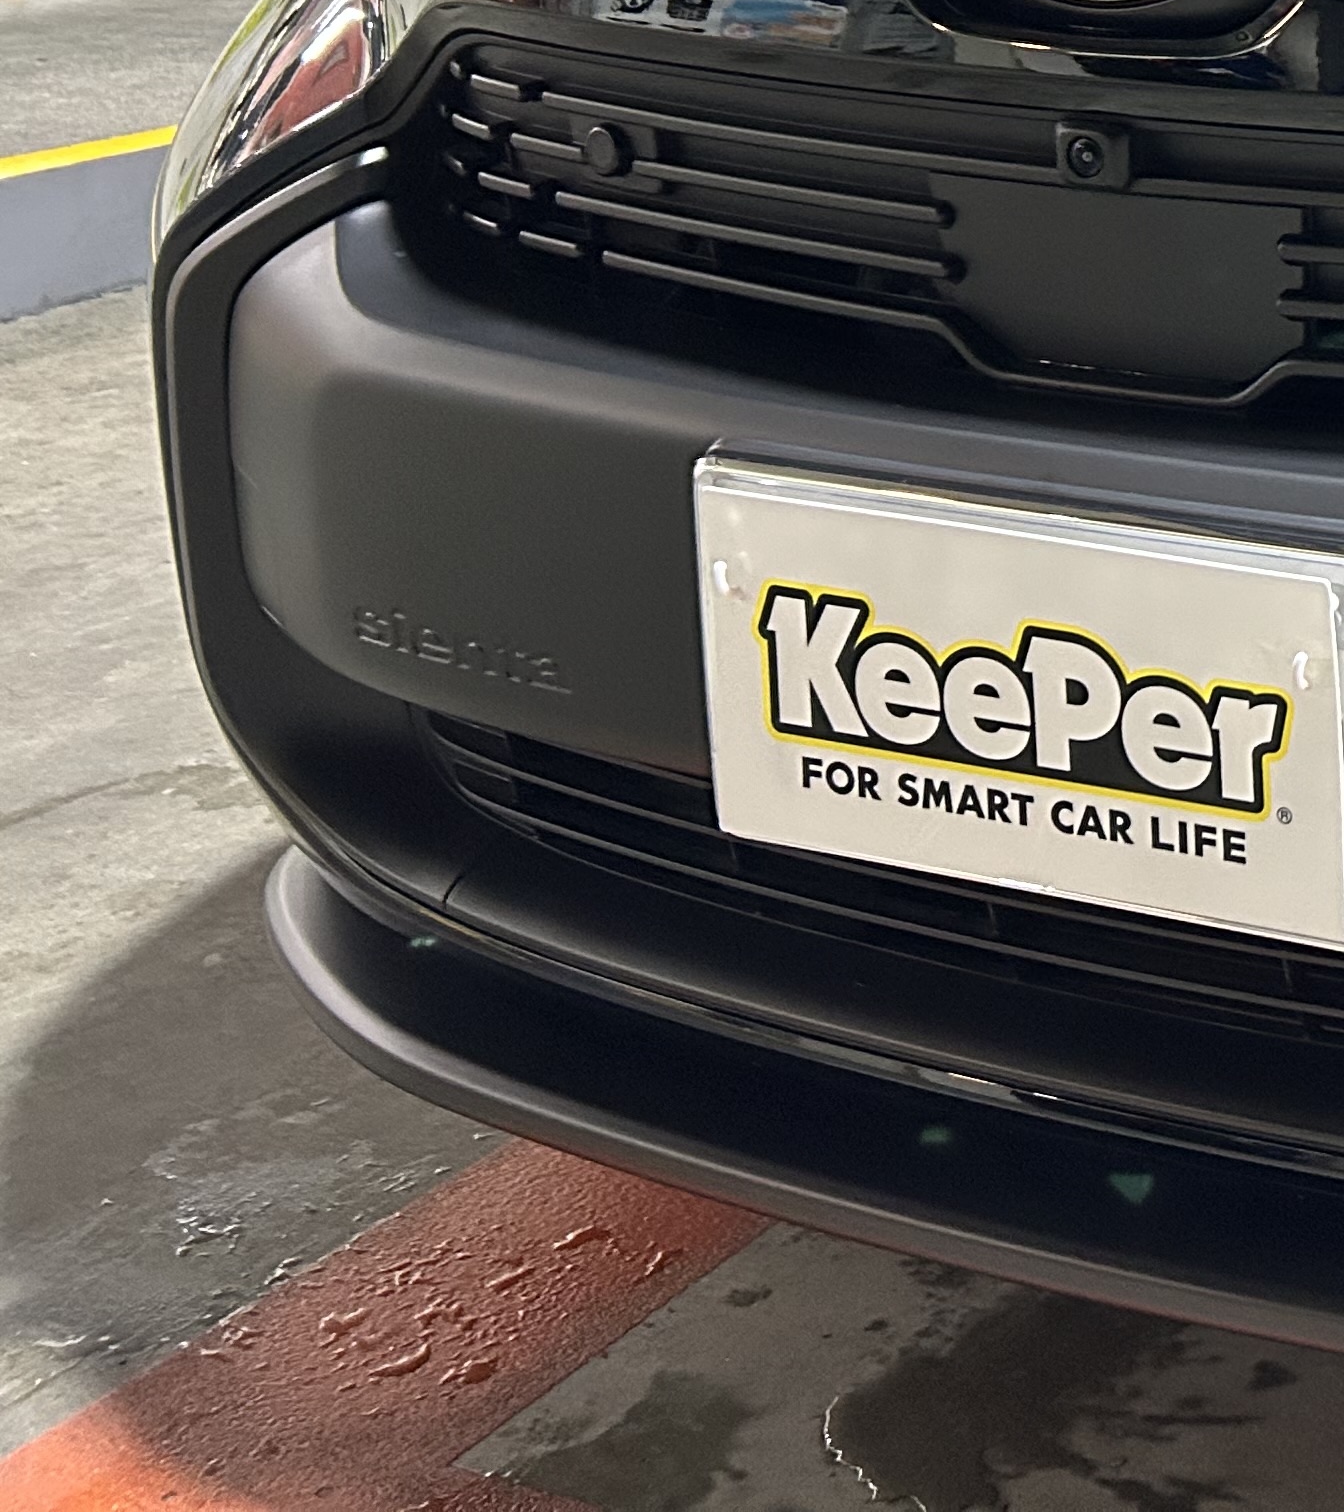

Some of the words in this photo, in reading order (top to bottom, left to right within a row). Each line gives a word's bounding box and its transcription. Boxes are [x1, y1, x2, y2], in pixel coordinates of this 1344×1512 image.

[760, 586, 1286, 814] KeePer
[802, 756, 882, 801] FOR
[898, 774, 1035, 826] SMART
[1051, 801, 1134, 845] CAR
[1151, 816, 1248, 865] LIFE
